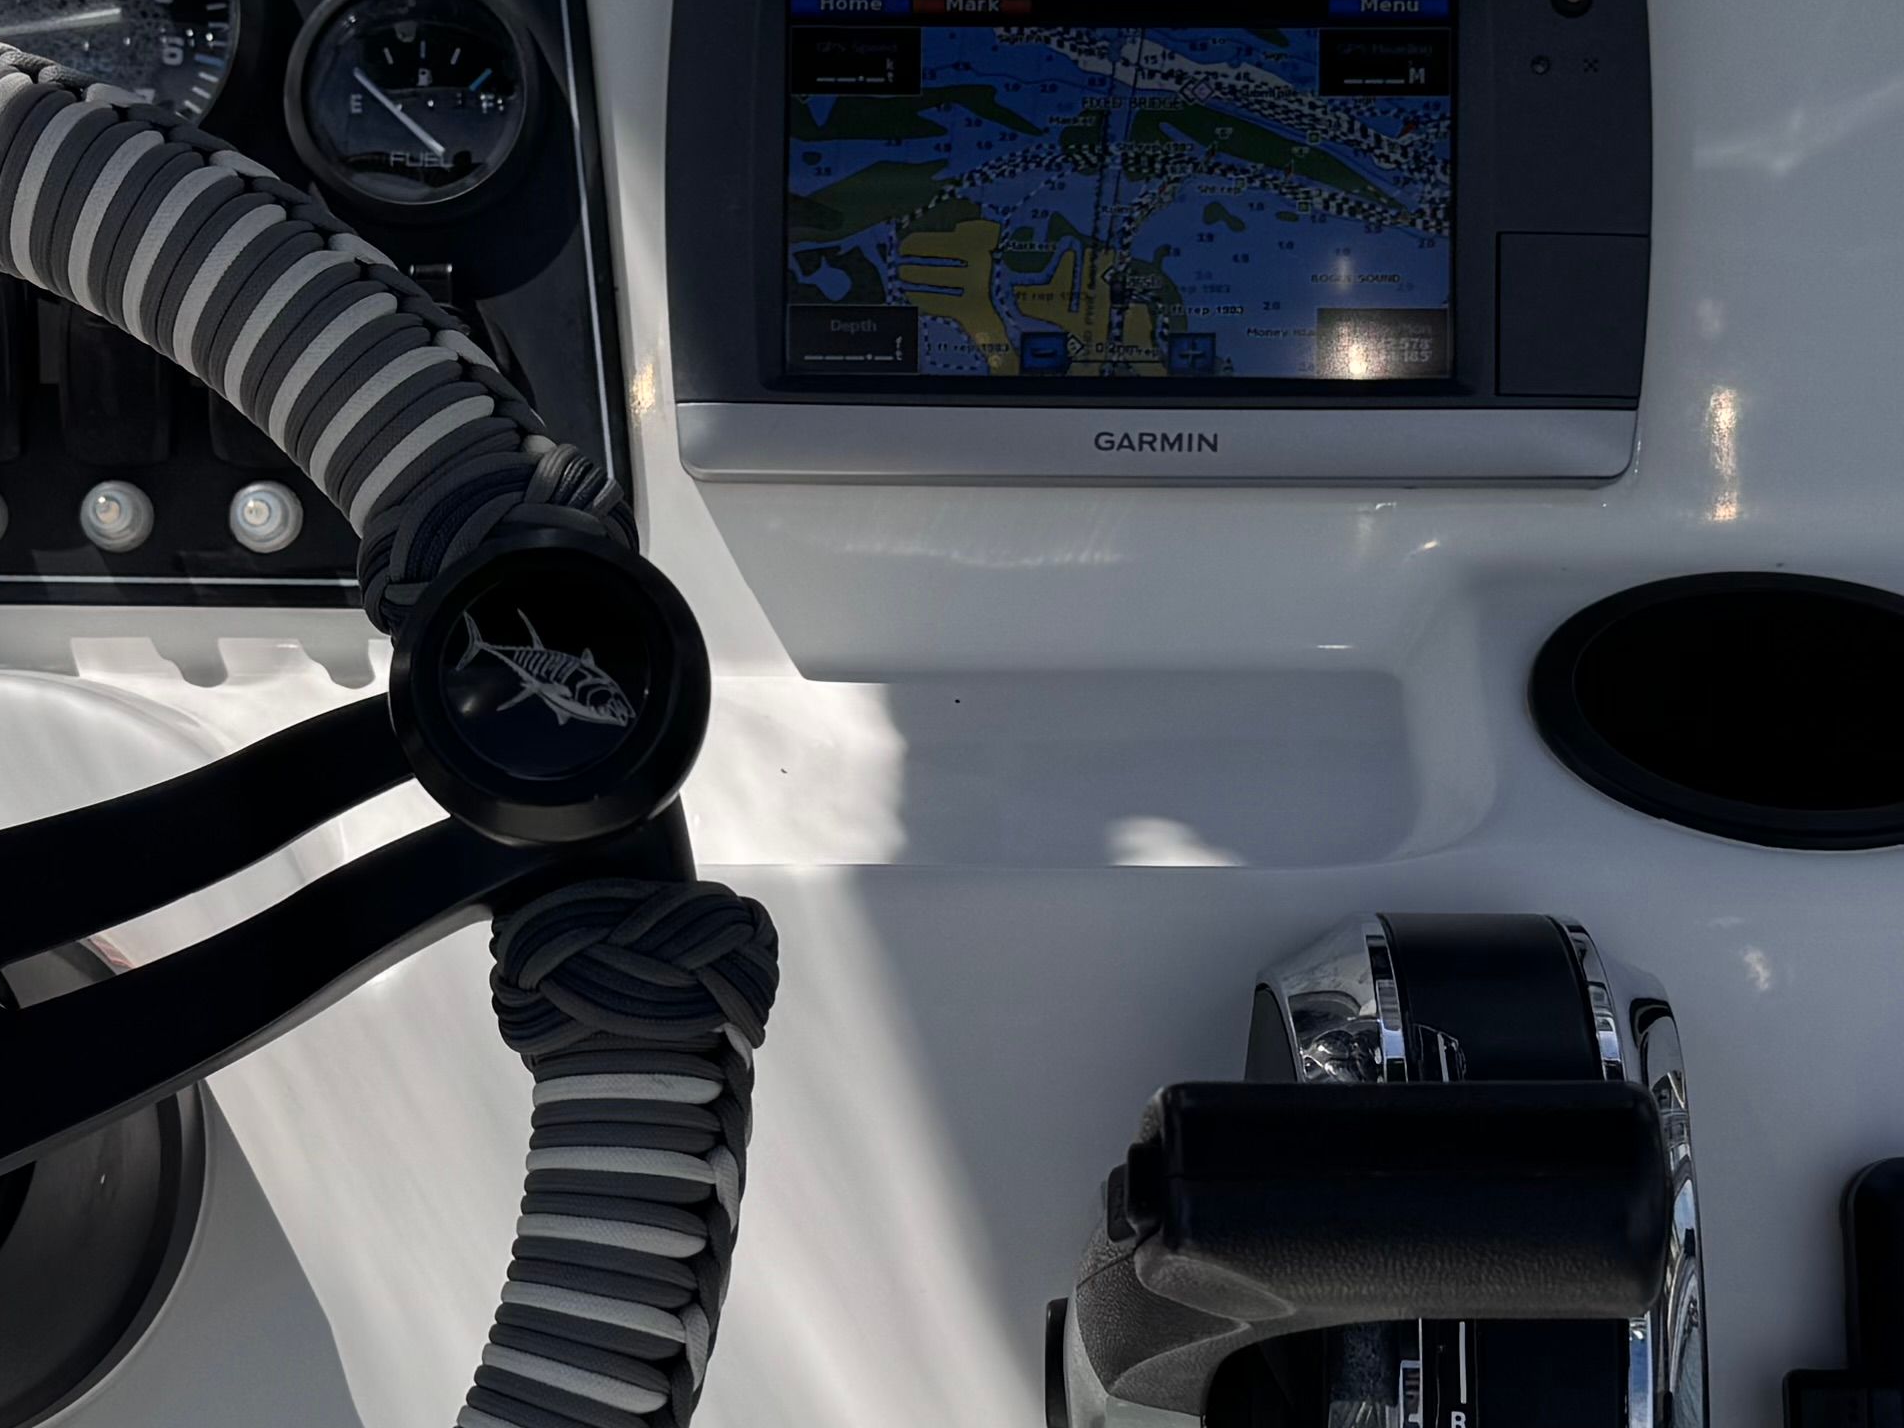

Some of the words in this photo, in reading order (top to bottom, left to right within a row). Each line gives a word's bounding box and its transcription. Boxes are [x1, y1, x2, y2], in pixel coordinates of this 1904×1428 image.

[162, 36, 185, 66] 6
[350, 93, 363, 115] E
[389, 150, 454, 169] FUEL
[1357, 273, 1401, 284] SOUND
[830, 318, 878, 335] Depth
[1093, 431, 1219, 454] GARMIN
